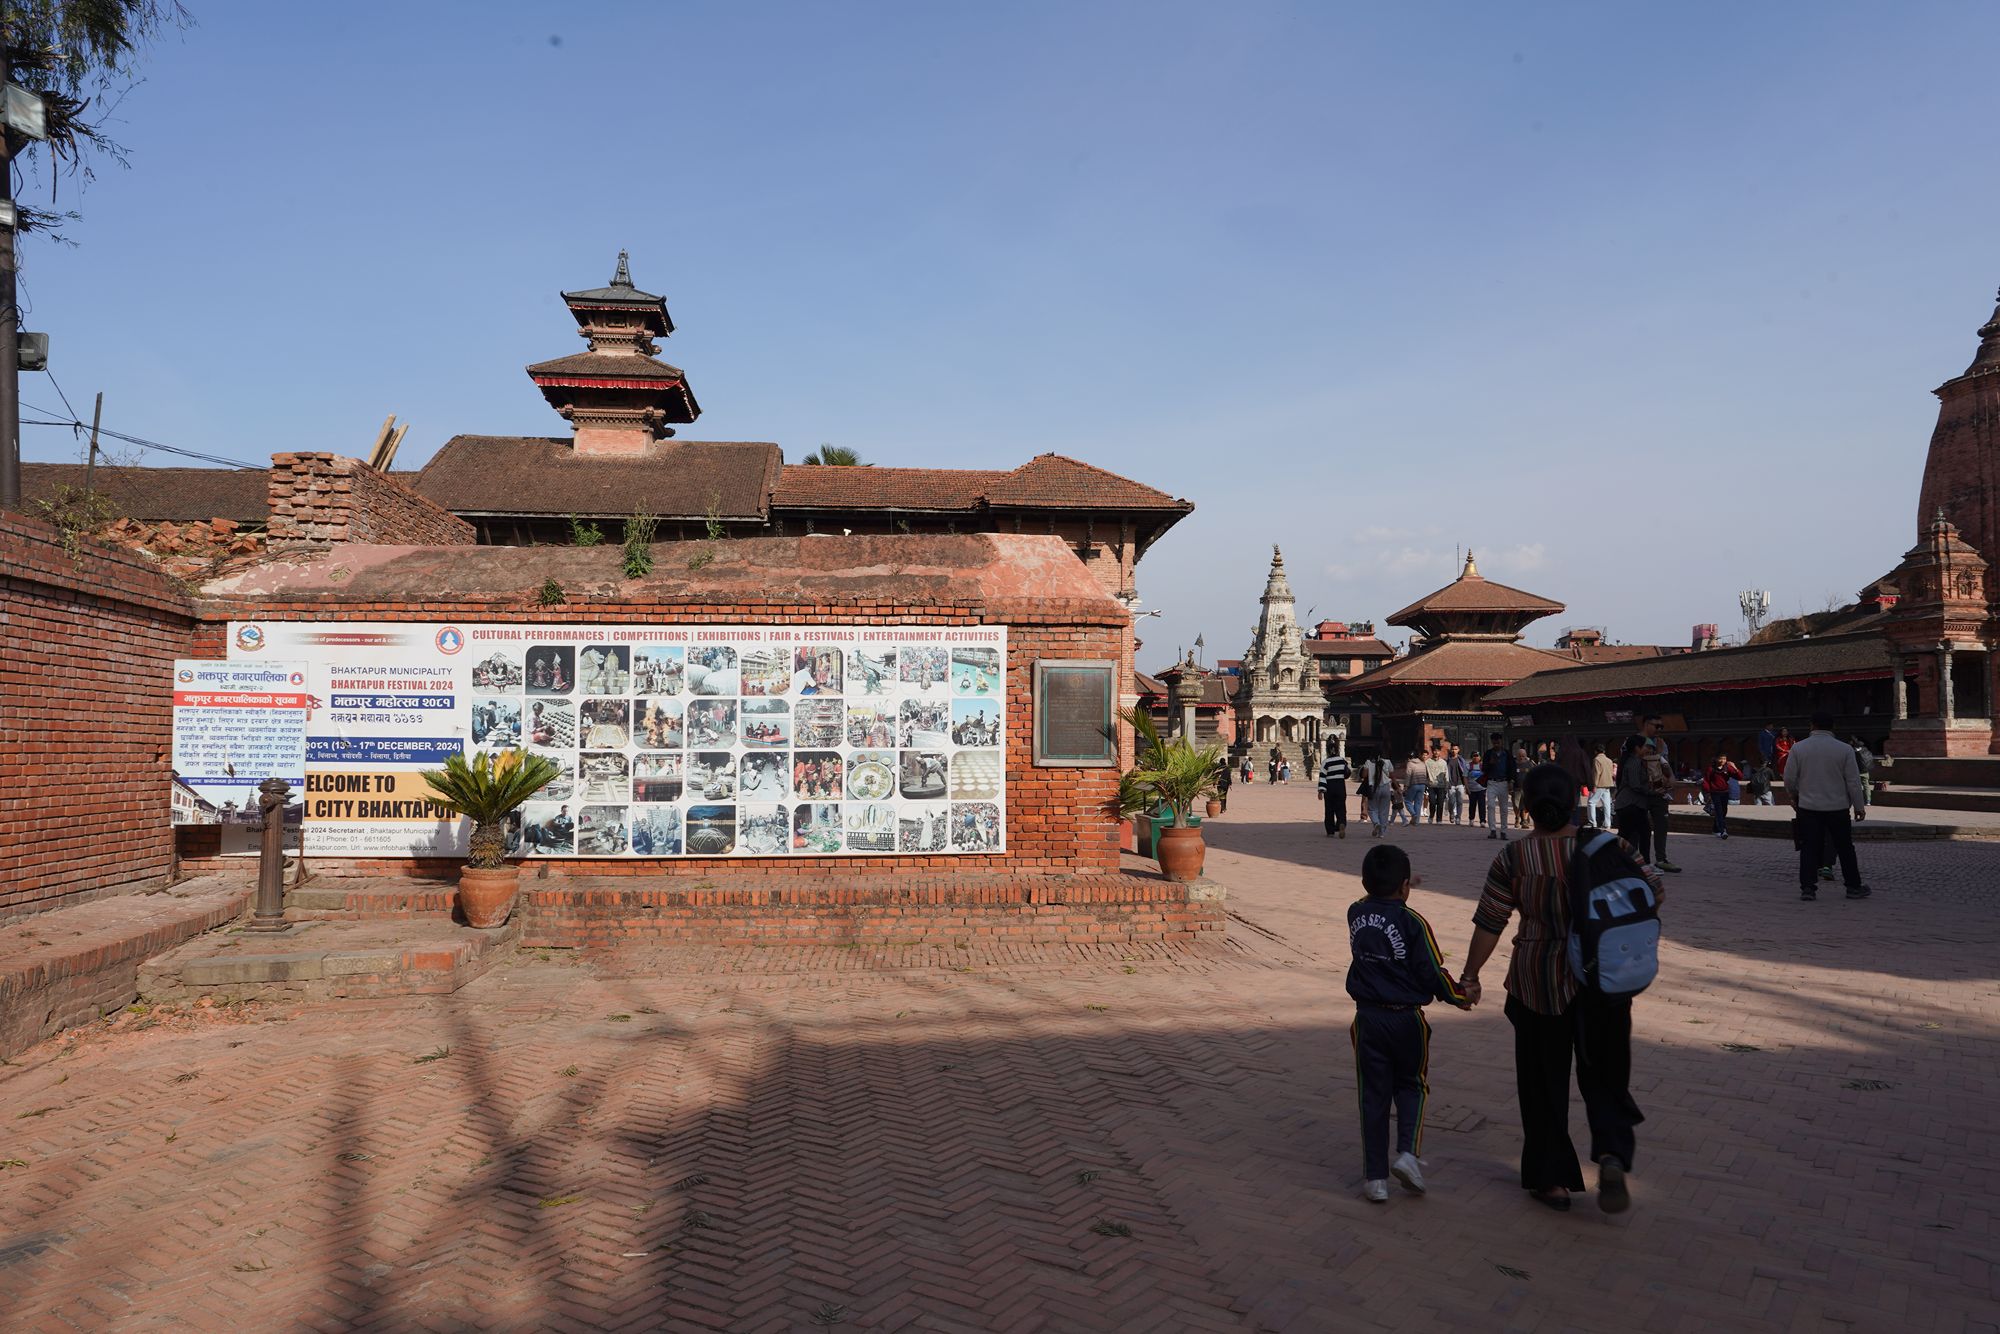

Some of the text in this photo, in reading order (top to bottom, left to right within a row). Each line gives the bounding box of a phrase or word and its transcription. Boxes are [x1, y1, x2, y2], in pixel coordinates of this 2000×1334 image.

[472, 630, 522, 640] CULTURAL
[525, 630, 604, 640] PERFORMANCES
[613, 631, 688, 640] COMPETITIONS
[697, 631, 761, 641] EXHIBITIONS
[770, 632, 791, 641] FAIR
[794, 632, 800, 641] &
[804, 632, 855, 641] FESTIVALS
[864, 632, 942, 641] ENTERTAINMENT
[945, 632, 999, 641] ACTIVITIES
[197, 670, 287, 683] भक्तपुर नगरपालिका
[390, 667, 452, 675] MUNICIPALITY
[331, 680, 453, 690] BHAKTAPUR FESTIVAL 2024
[214, 694, 272, 704] नगरपालिकाको
[274, 696, 297, 706] सूचना
[334, 694, 450, 708] भक्तपुर महोत्सव २०८१
[360, 742, 375, 750] 17th
[378, 742, 434, 751] DECEMBER,
[436, 742, 460, 752] 2024)
[304, 774, 370, 792] ELCOME
[374, 775, 395, 793] TO
[316, 800, 354, 817] CITY
[1384, 924, 1407, 960] SCHOOL
